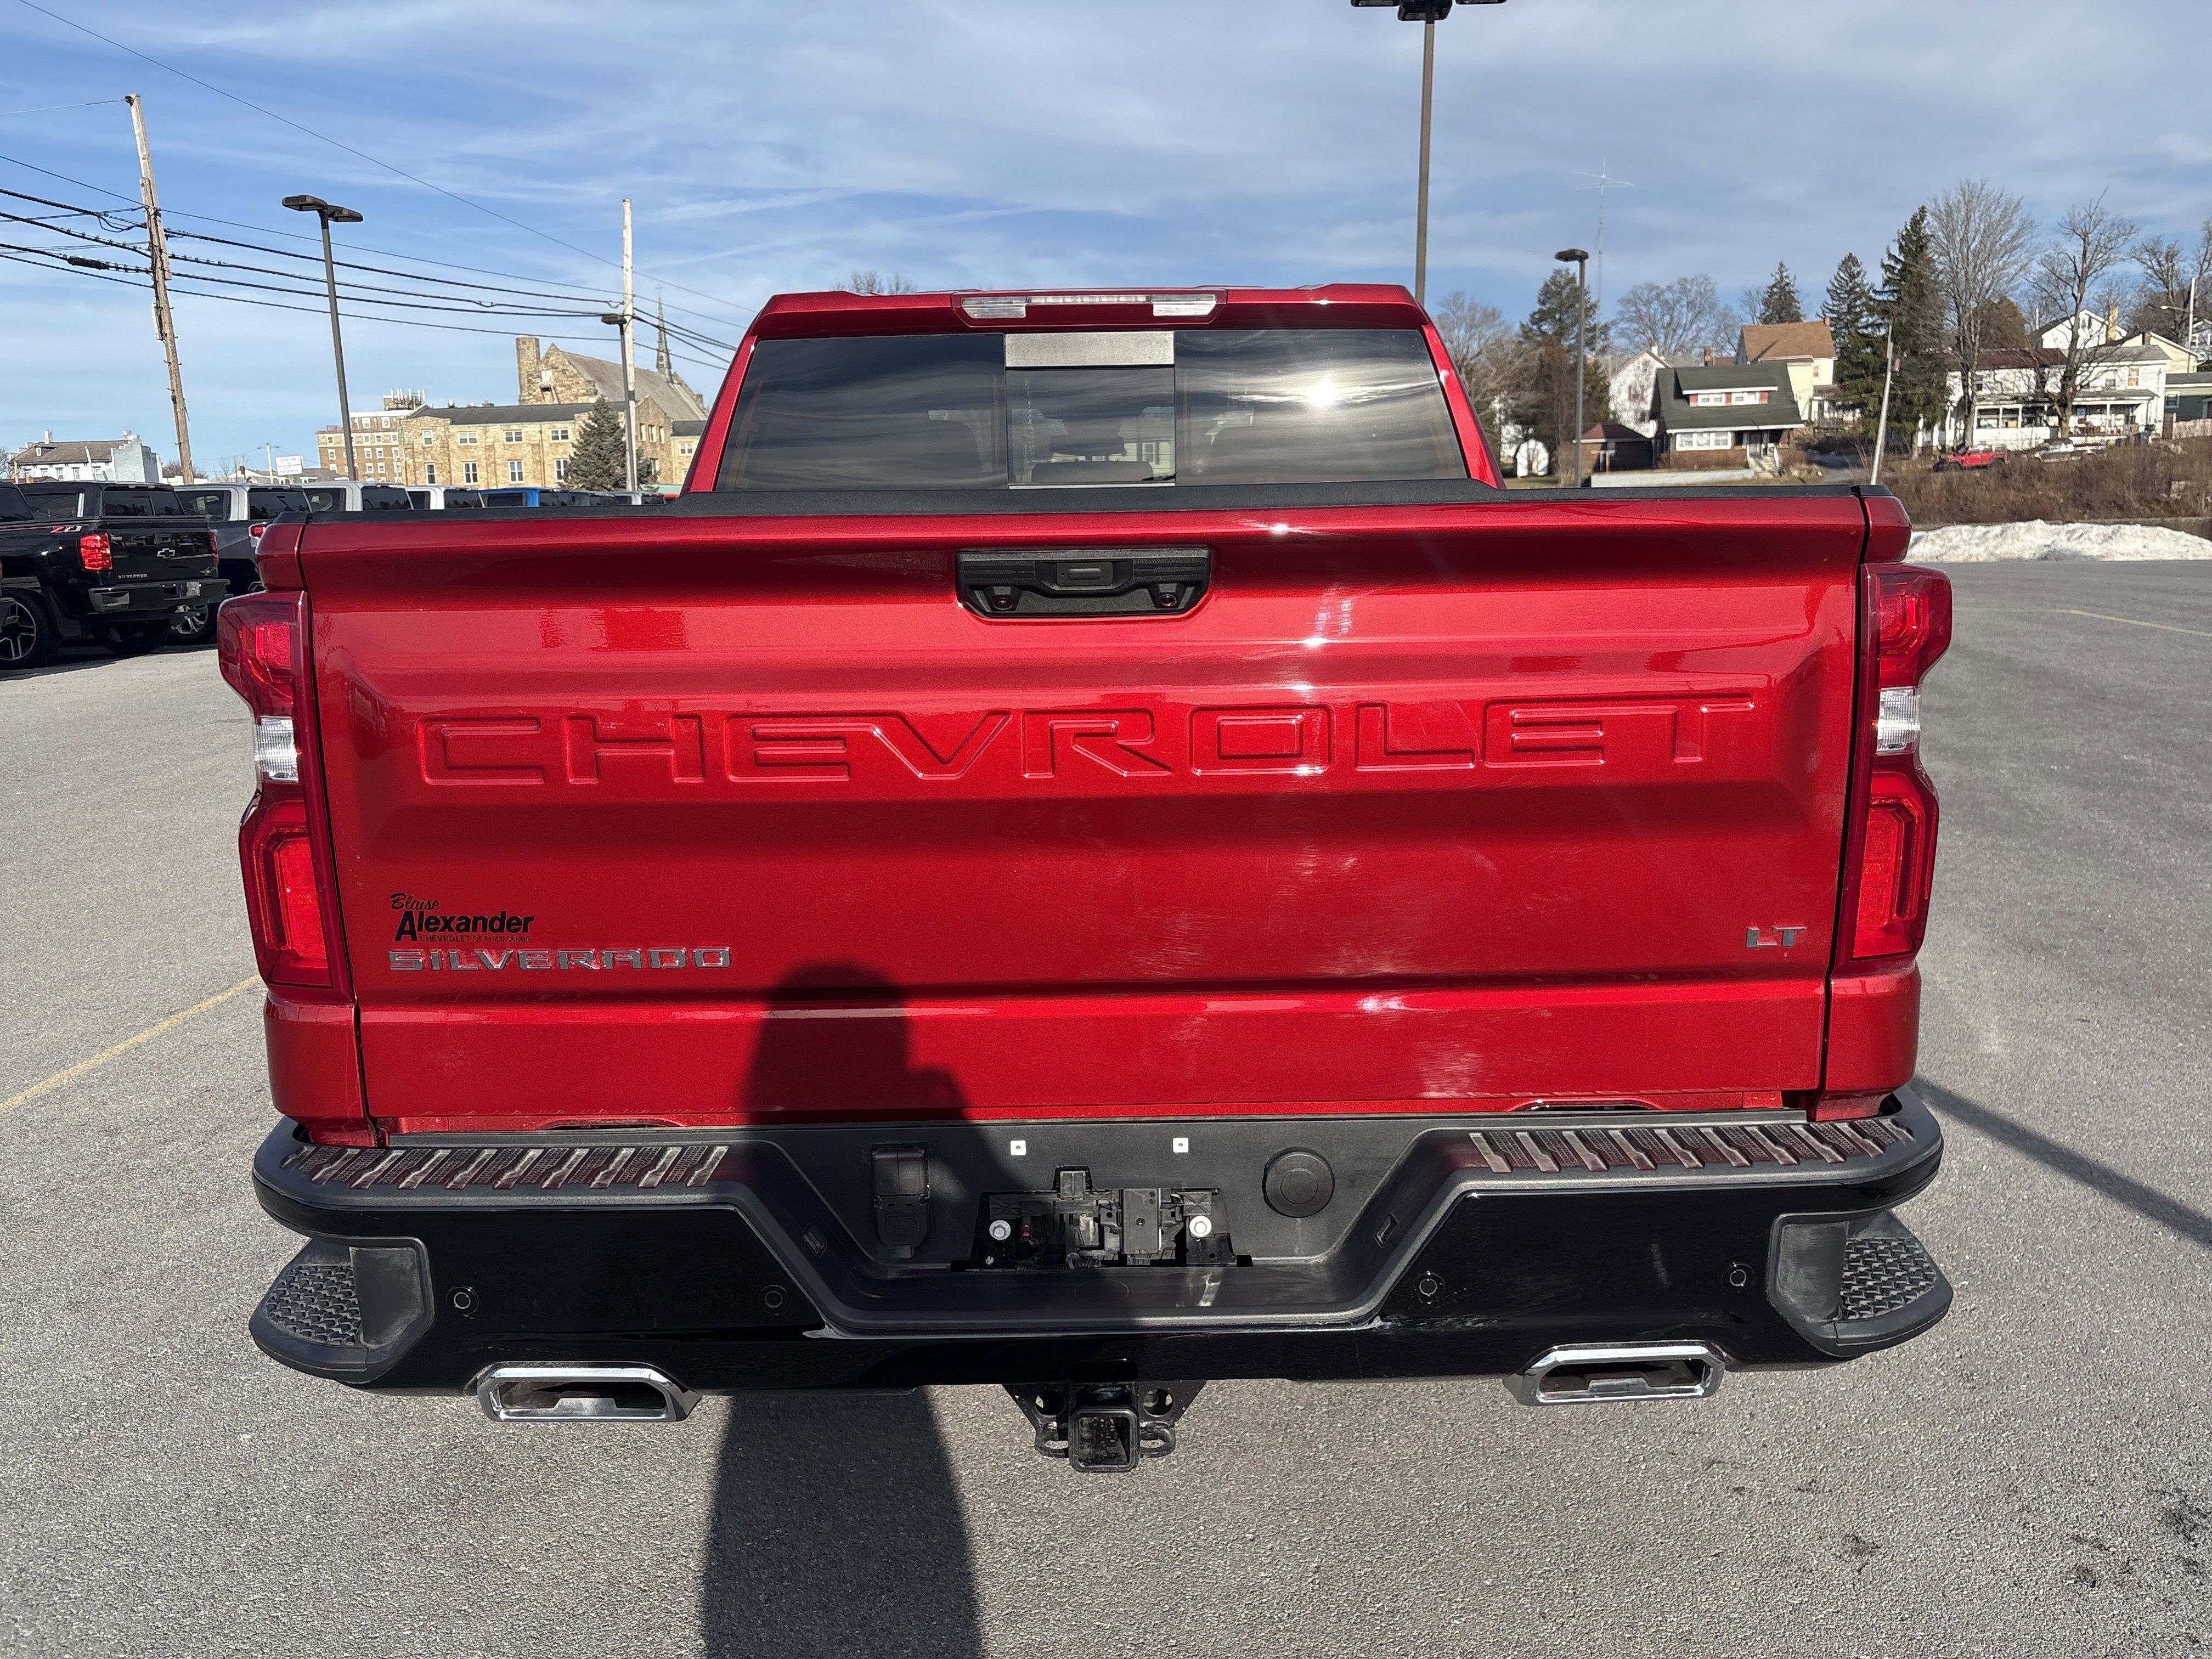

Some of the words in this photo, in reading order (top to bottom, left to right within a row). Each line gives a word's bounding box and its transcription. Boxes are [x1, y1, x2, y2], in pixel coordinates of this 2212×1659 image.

[50, 526, 82, 534] Z71
[417, 692, 1756, 785] CHEVROLET
[389, 893, 441, 911] Blaise
[394, 911, 535, 941] Alexander
[1745, 925, 1807, 949] LT
[420, 934, 470, 943] CHEVROLET
[473, 934, 484, 943] OF
[387, 948, 732, 971] SILVERADO
